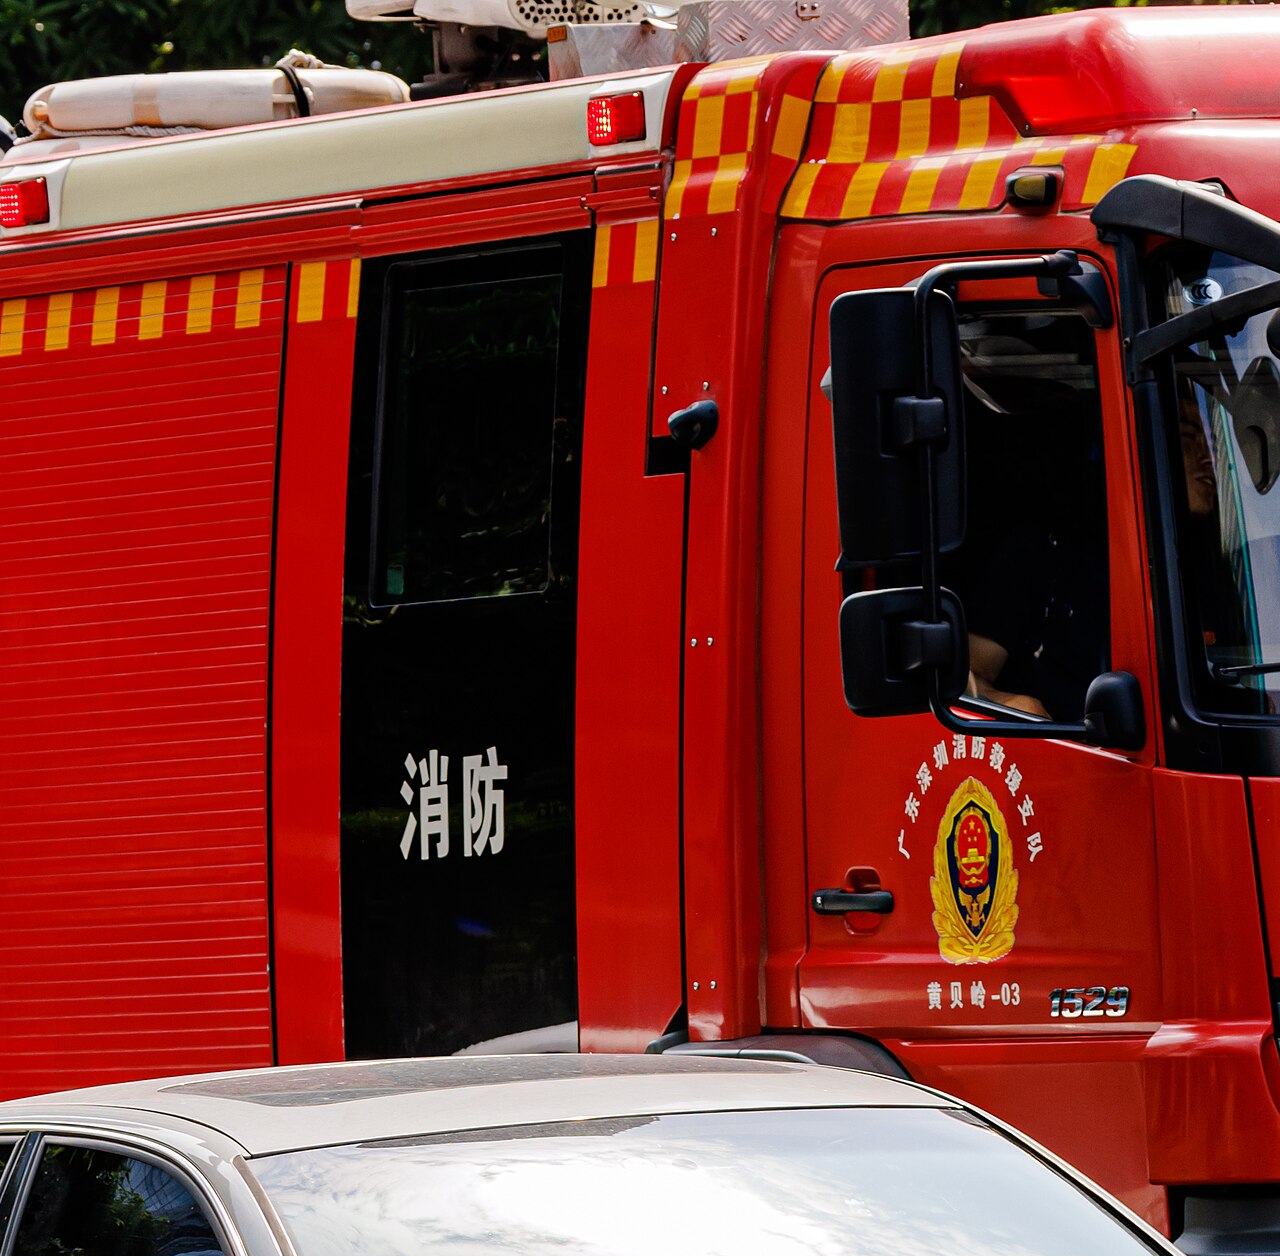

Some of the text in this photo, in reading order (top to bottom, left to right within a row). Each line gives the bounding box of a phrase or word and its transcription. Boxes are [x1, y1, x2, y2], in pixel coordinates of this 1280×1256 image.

[399, 745, 509, 861] 消防
[897, 733, 1045, 863] 广东深圳消防救援支队
[926, 980, 1021, 1011] 黄贝岭-03
[1048, 985, 1131, 1019] 1529
